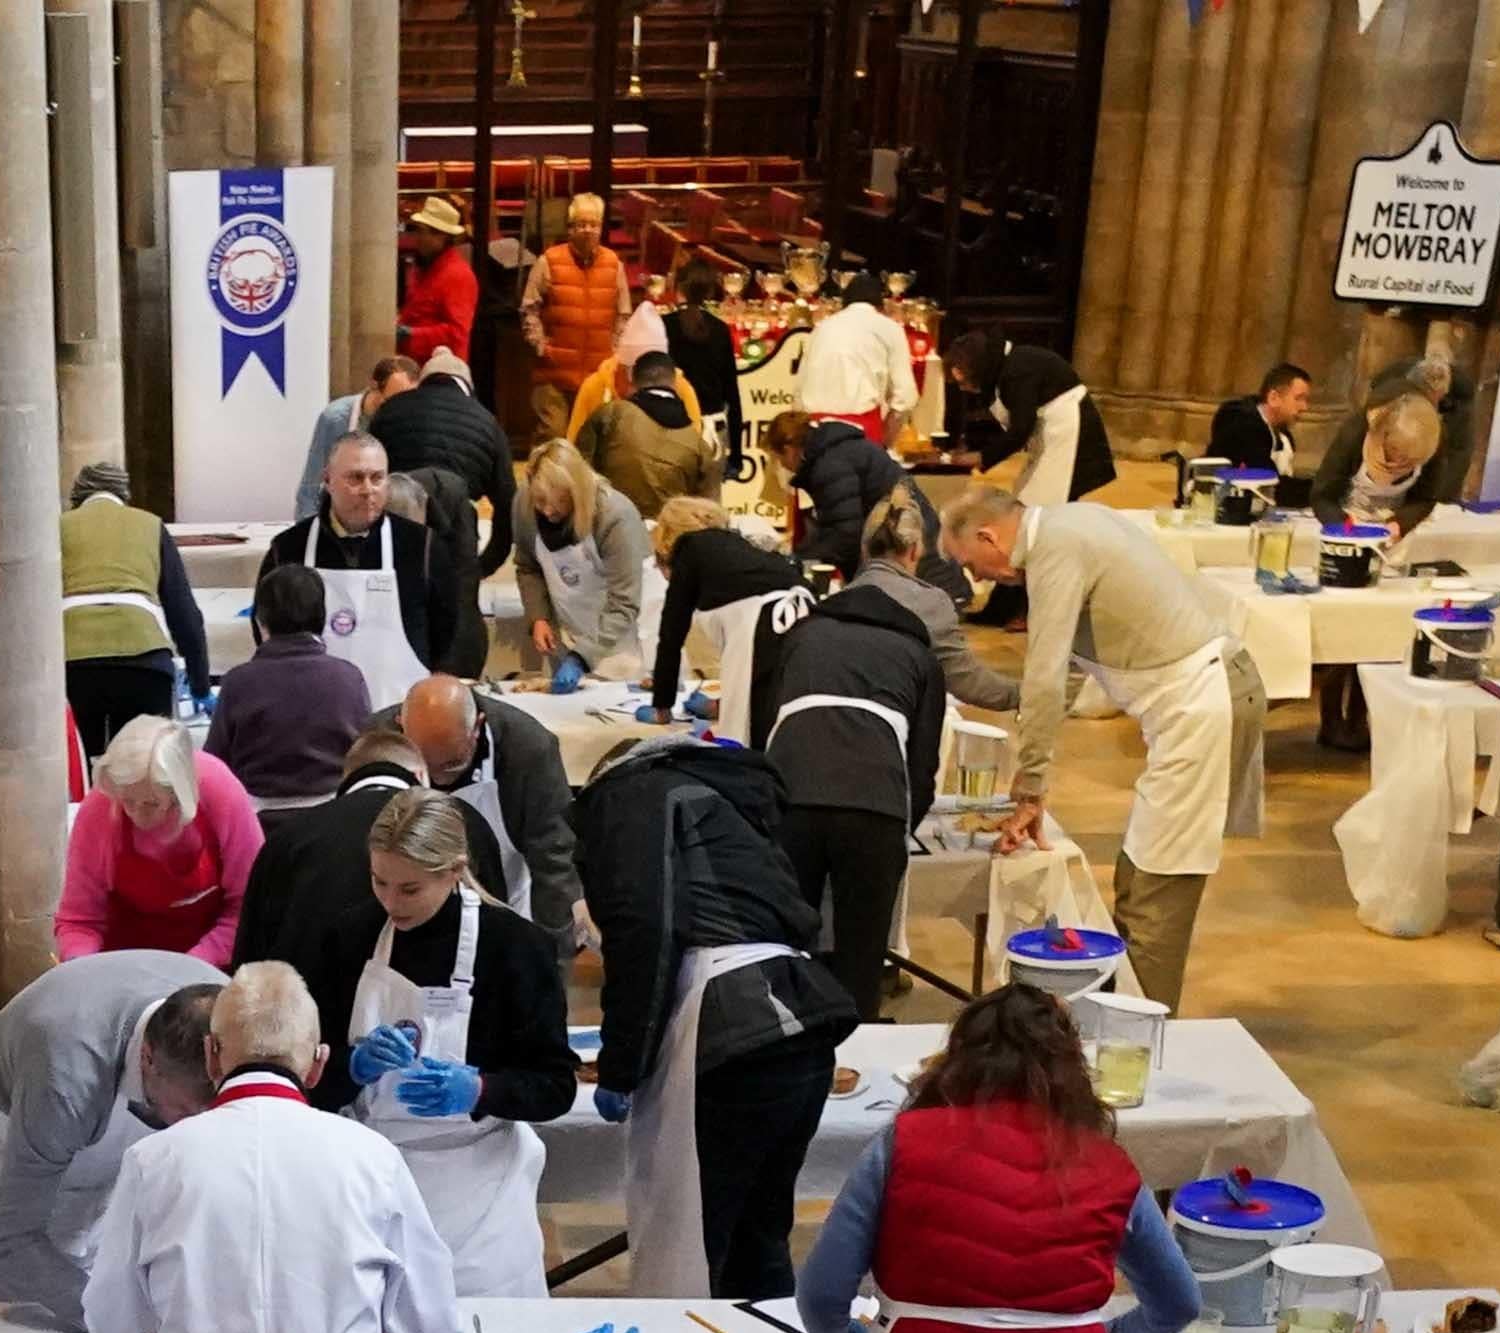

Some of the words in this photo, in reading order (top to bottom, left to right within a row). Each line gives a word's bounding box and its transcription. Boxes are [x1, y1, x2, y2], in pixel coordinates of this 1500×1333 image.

[1396, 174, 1450, 191] Welcome
[1453, 177, 1465, 190] to
[1372, 201, 1476, 232] MELTON
[1351, 231, 1487, 265] MOWBRAY
[1348, 274, 1380, 291] Rural
[1382, 276, 1424, 295] Capital
[1426, 277, 1441, 294] of
[1444, 278, 1475, 297] Food
